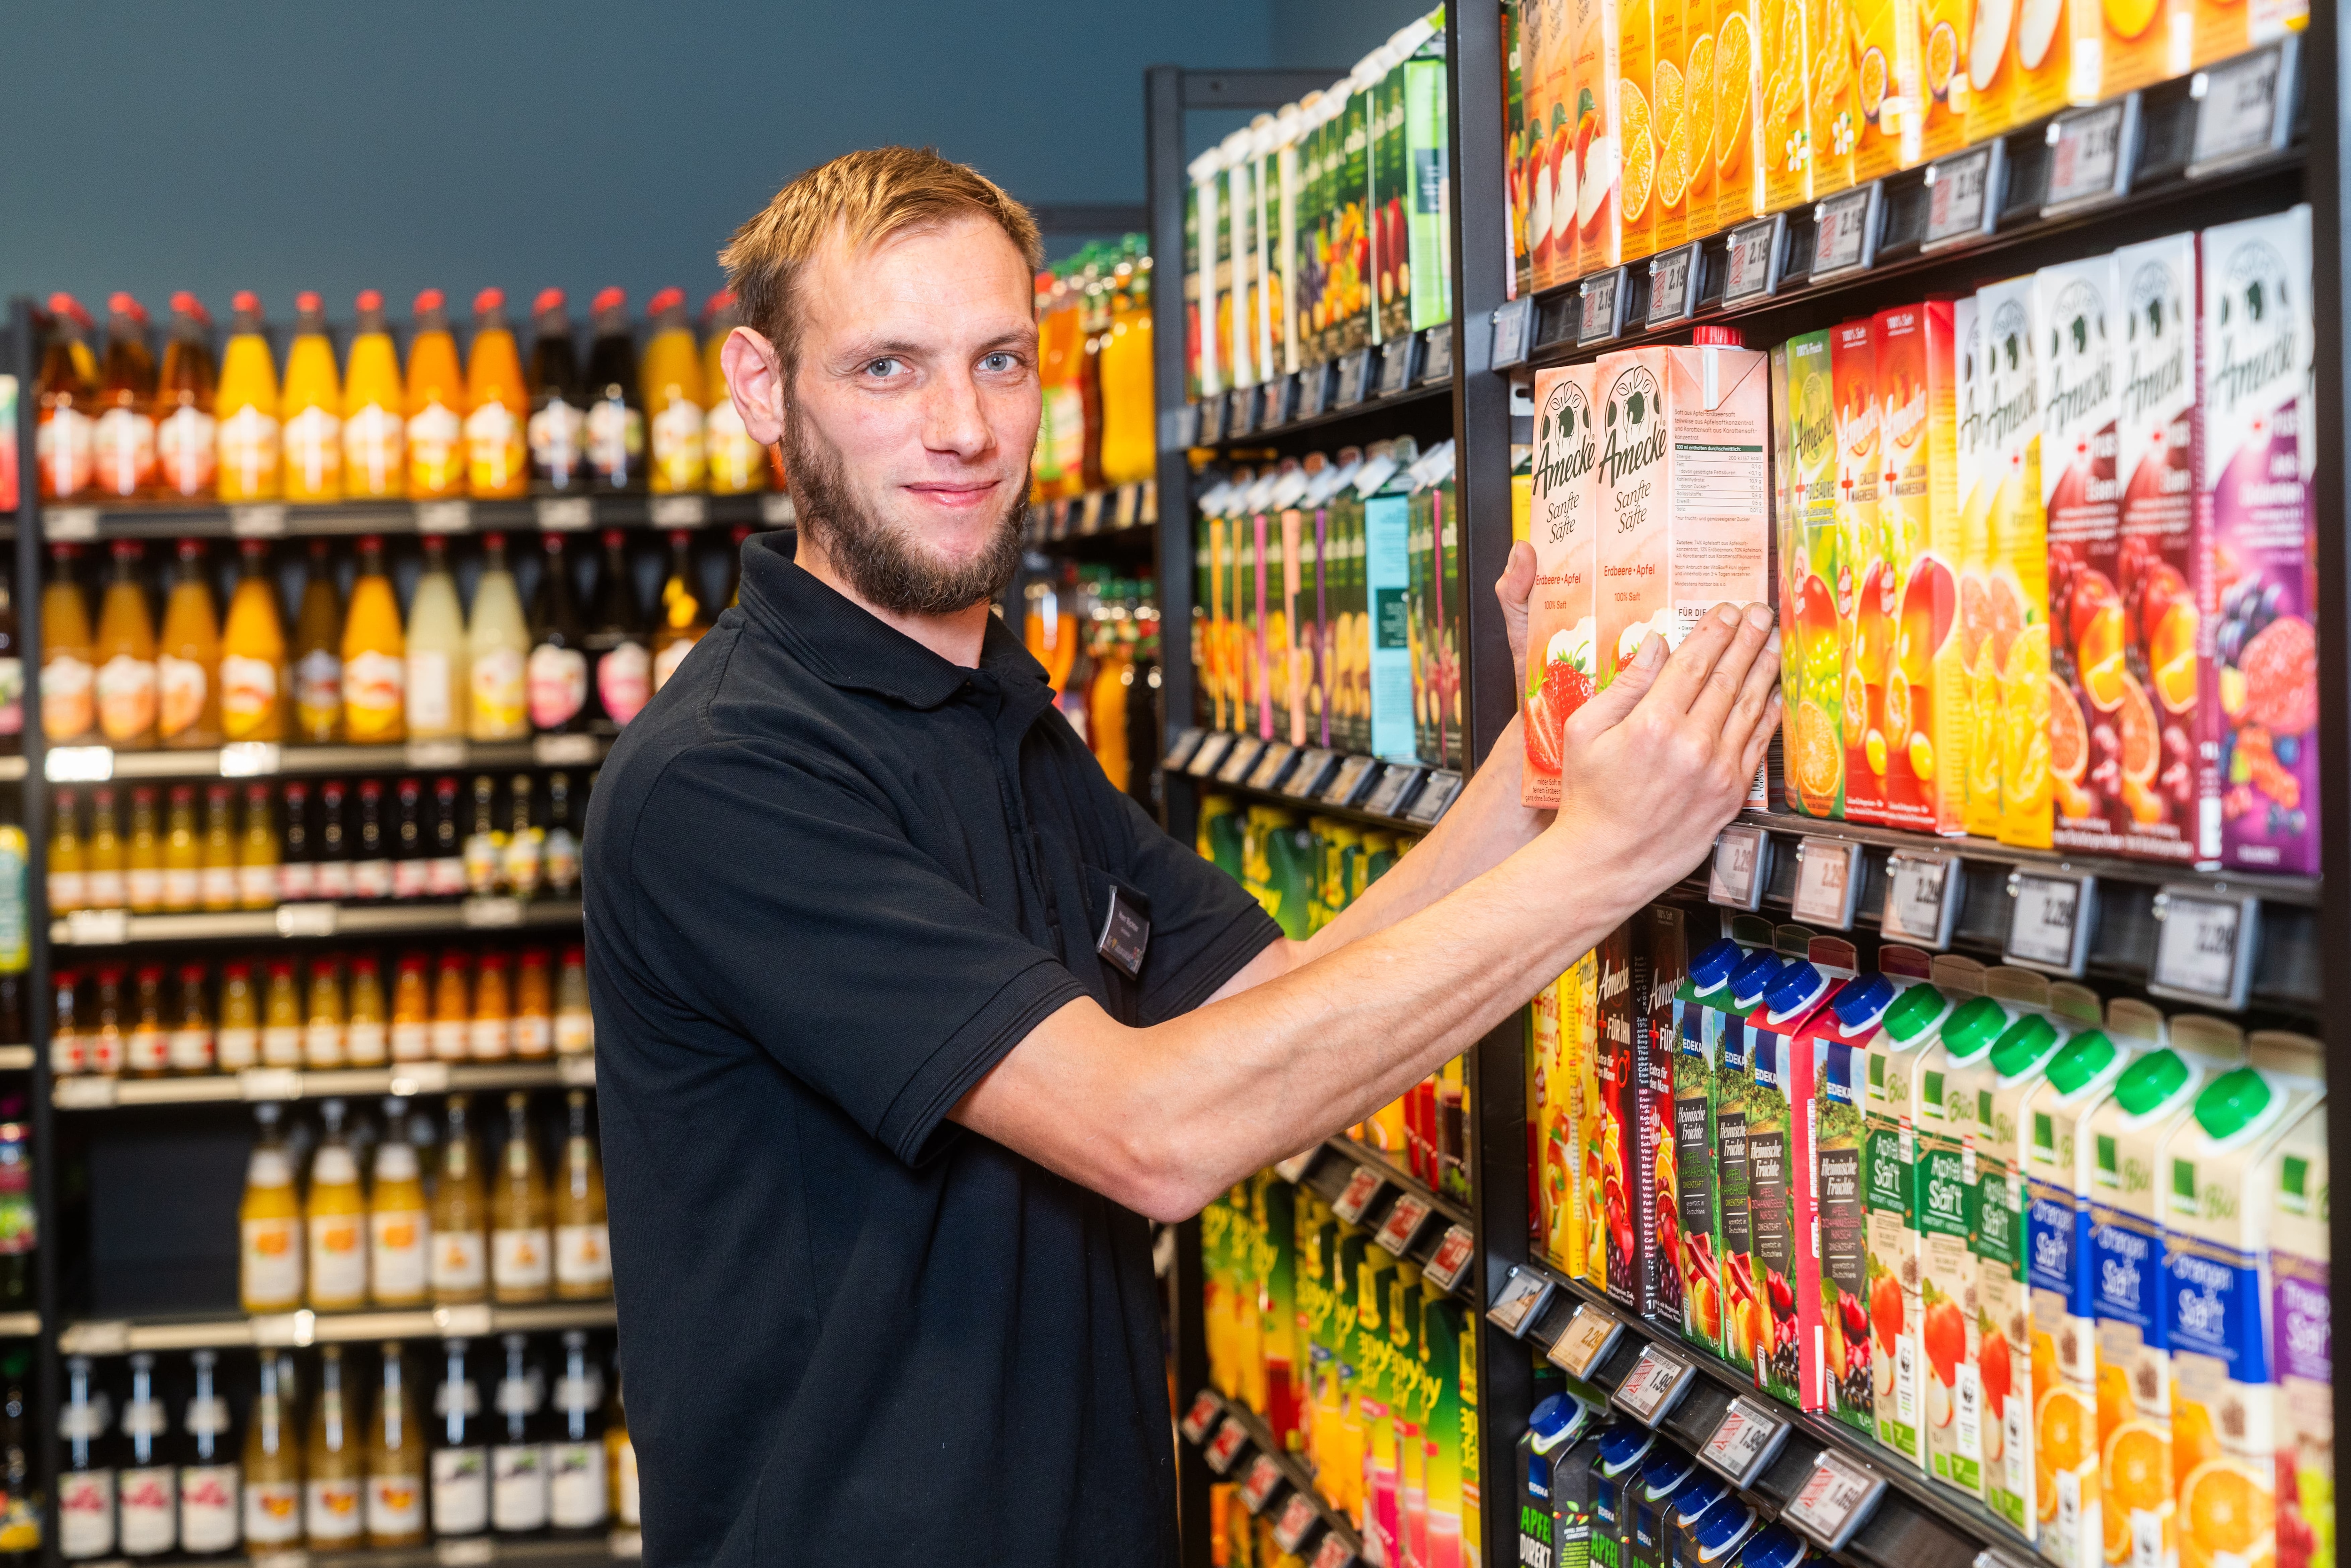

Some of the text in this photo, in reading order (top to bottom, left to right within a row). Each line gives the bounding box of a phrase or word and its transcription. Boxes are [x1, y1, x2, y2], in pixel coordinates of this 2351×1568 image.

[1598, 420, 1667, 488] Amecke
[1533, 434, 1595, 500] Amecke
[1615, 480, 1650, 512] Sanfte
[1546, 492, 1579, 522] Sanfte
[1618, 505, 1647, 533] Säfte
[1550, 516, 1575, 544] Säfte
[1604, 564, 1655, 577] Erdbeere Apfel
[1536, 573, 1581, 586] Erdbeere Apfel
[1545, 601, 1555, 609] 100%
[1615, 592, 1640, 601] 100% Saft
[1679, 607, 1692, 616] FÜR
[1597, 958, 1629, 1005] Amecke
[1607, 1013, 1620, 1041] FÜR
[1660, 1024, 1673, 1053] FÜR
[1683, 1038, 1702, 1053] EDEKA
[1725, 1051, 1745, 1066] EDEKA
[1649, 1063, 1660, 1077] Extra
[1755, 1068, 1777, 1084] EDEKA
[1657, 1079, 1669, 1094] Mann
[1827, 1082, 1852, 1099] EDEKA
[1678, 1105, 1705, 1124] Heimische
[1682, 1123, 1703, 1140] Früchte
[1720, 1120, 1746, 1140] Heimische
[1724, 1139, 1745, 1157] Früchte
[1751, 1140, 1782, 1160] Heimische
[1683, 1152, 1701, 1164] APFEL
[1679, 1165, 1708, 1178] RHABARBER
[1726, 1169, 1743, 1181] APFEL
[1755, 1159, 1780, 1177] Früchte
[1649, 1369, 1673, 1394] 1.99
[1529, 1481, 1548, 1497] EDEKA
